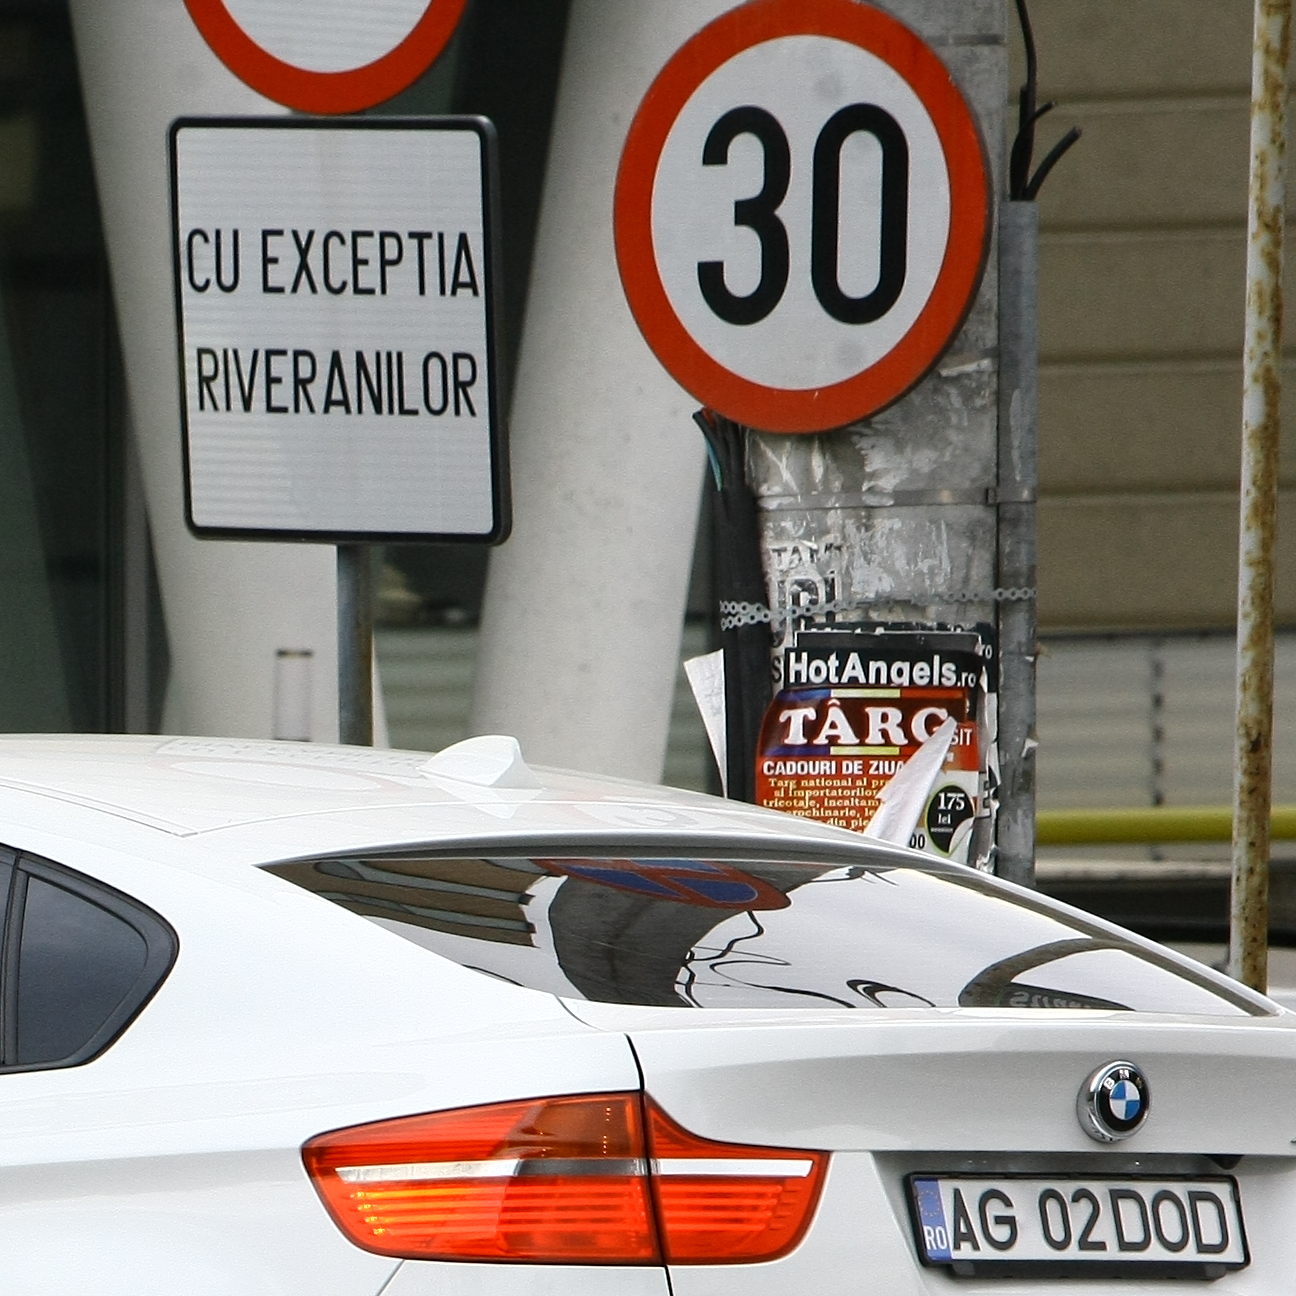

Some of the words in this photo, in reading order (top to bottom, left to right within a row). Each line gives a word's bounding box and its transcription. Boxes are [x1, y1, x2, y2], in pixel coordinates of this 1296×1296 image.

[696, 102, 910, 325] 30
[186, 228, 240, 294] CU
[262, 228, 479, 299] EXCEPTIA
[196, 348, 478, 417] RIVERANILOR
[788, 651, 976, 687] HotAngels.ro
[779, 698, 951, 746] TÂRG
[763, 760, 836, 775] CADOURI
[842, 760, 863, 775] DE
[801, 777, 852, 787] national
[856, 777, 867, 787] al
[824, 798, 881, 807] incaltam
[938, 792, 965, 811] 175
[938, 813, 951, 825] lei
[953, 1188, 1018, 1252] AG
[924, 1226, 948, 1250] RO
